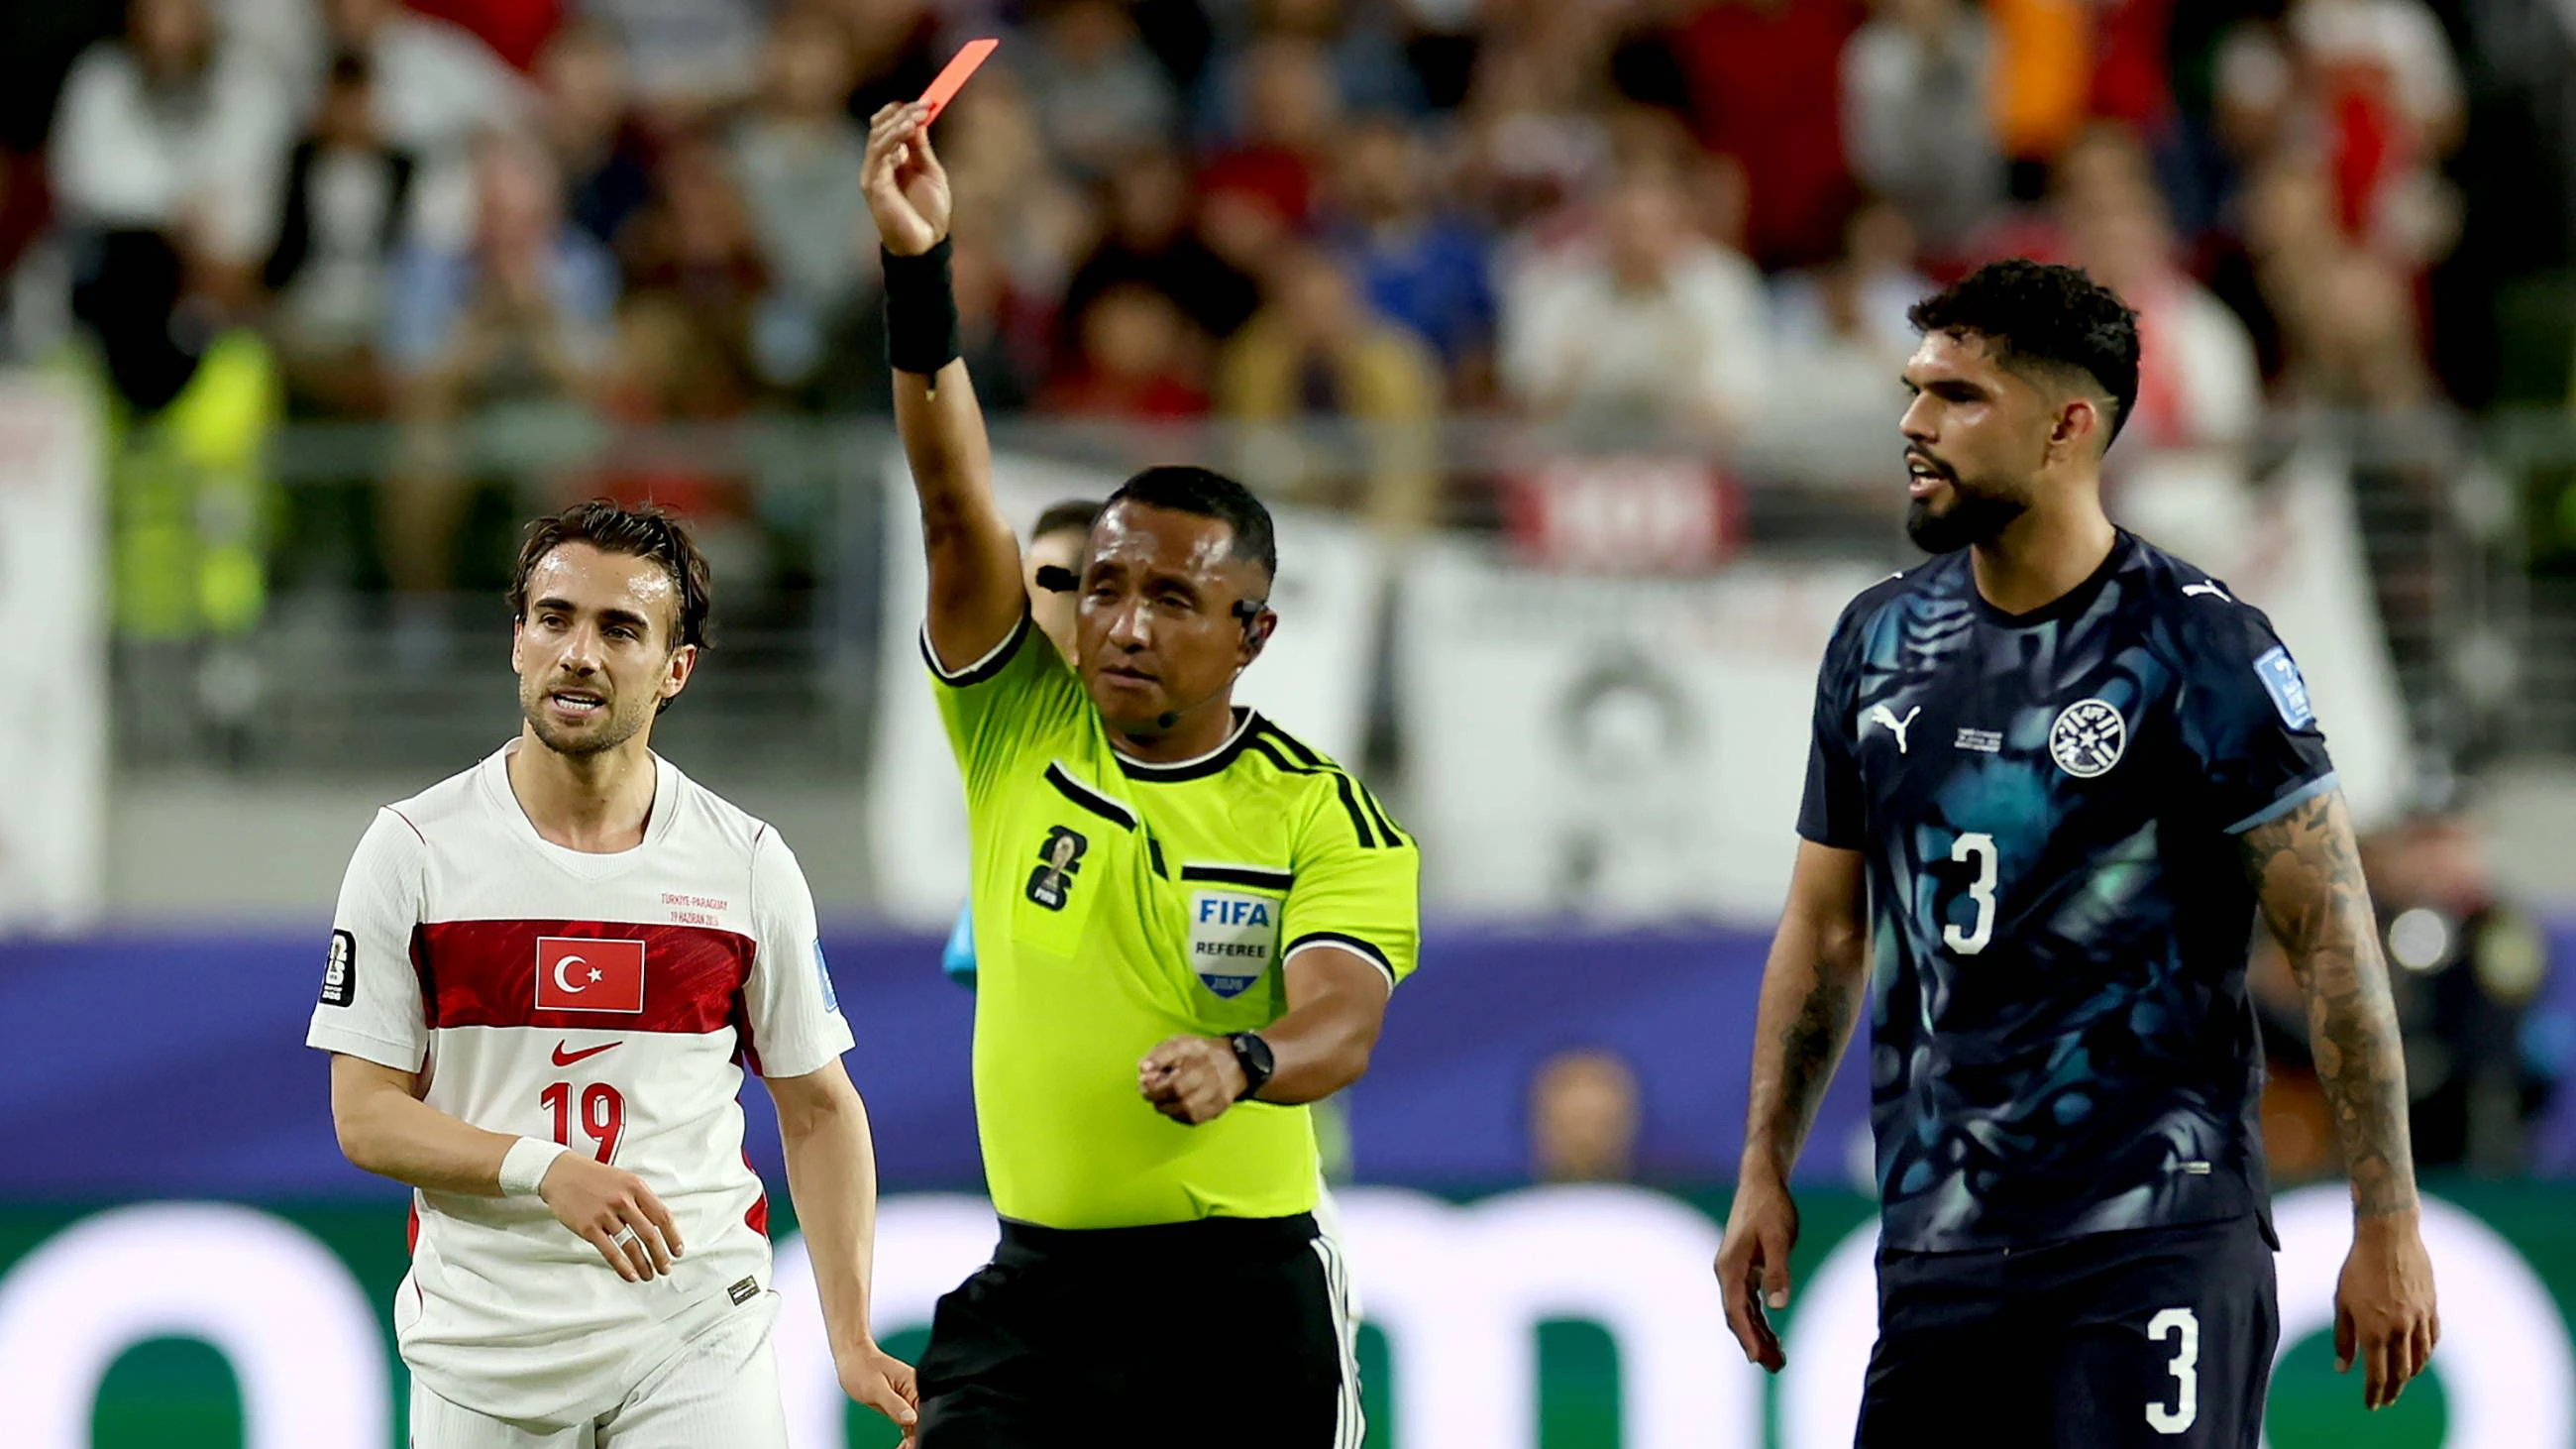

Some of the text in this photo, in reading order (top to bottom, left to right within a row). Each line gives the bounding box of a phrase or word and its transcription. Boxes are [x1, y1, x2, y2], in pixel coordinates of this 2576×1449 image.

[1199, 899, 1270, 928] FIFA
[1943, 832, 1998, 954] 3
[1195, 941, 1267, 958] REFEREE
[540, 1081, 626, 1167] 19
[2145, 1307, 2199, 1434] 3
